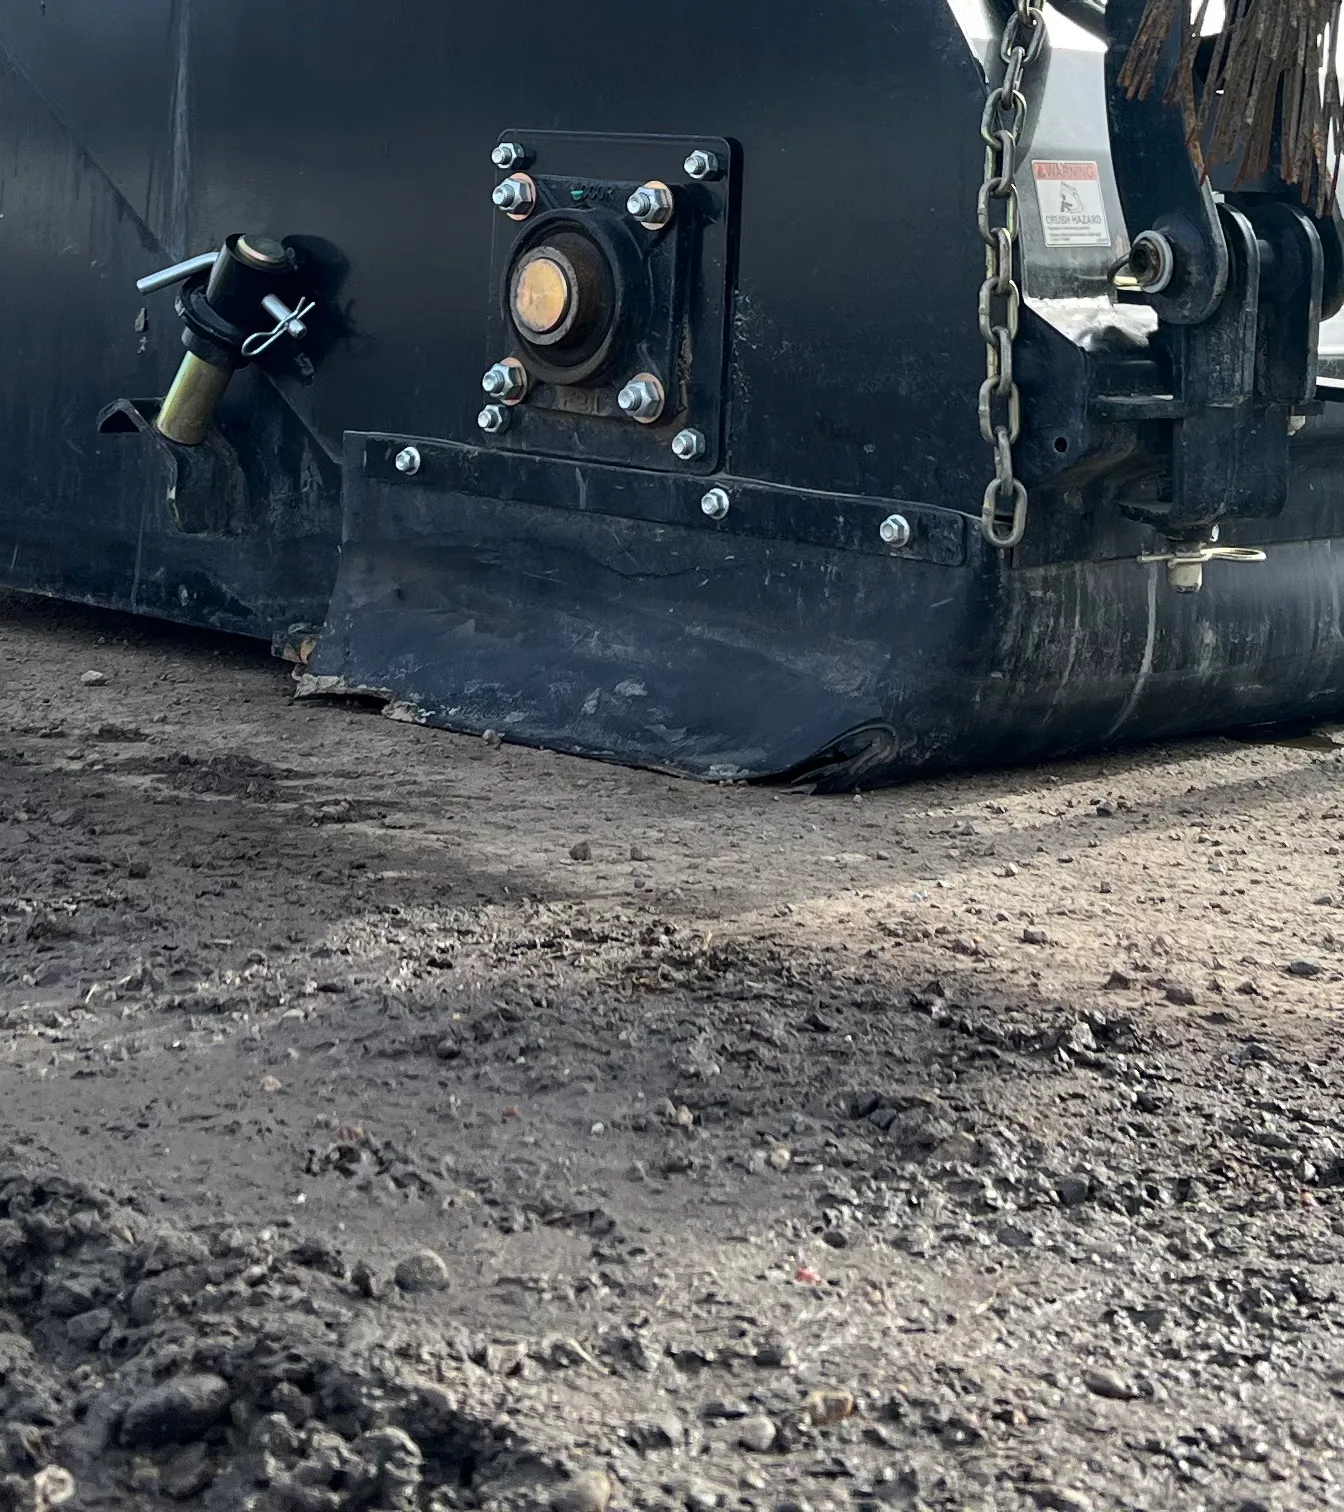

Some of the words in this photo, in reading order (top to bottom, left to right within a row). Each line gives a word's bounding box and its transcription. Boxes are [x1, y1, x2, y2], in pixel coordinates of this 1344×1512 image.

[1047, 163, 1094, 178] WARNING
[1045, 215, 1071, 224] CRUSH
[1072, 215, 1102, 224] HAZARD
